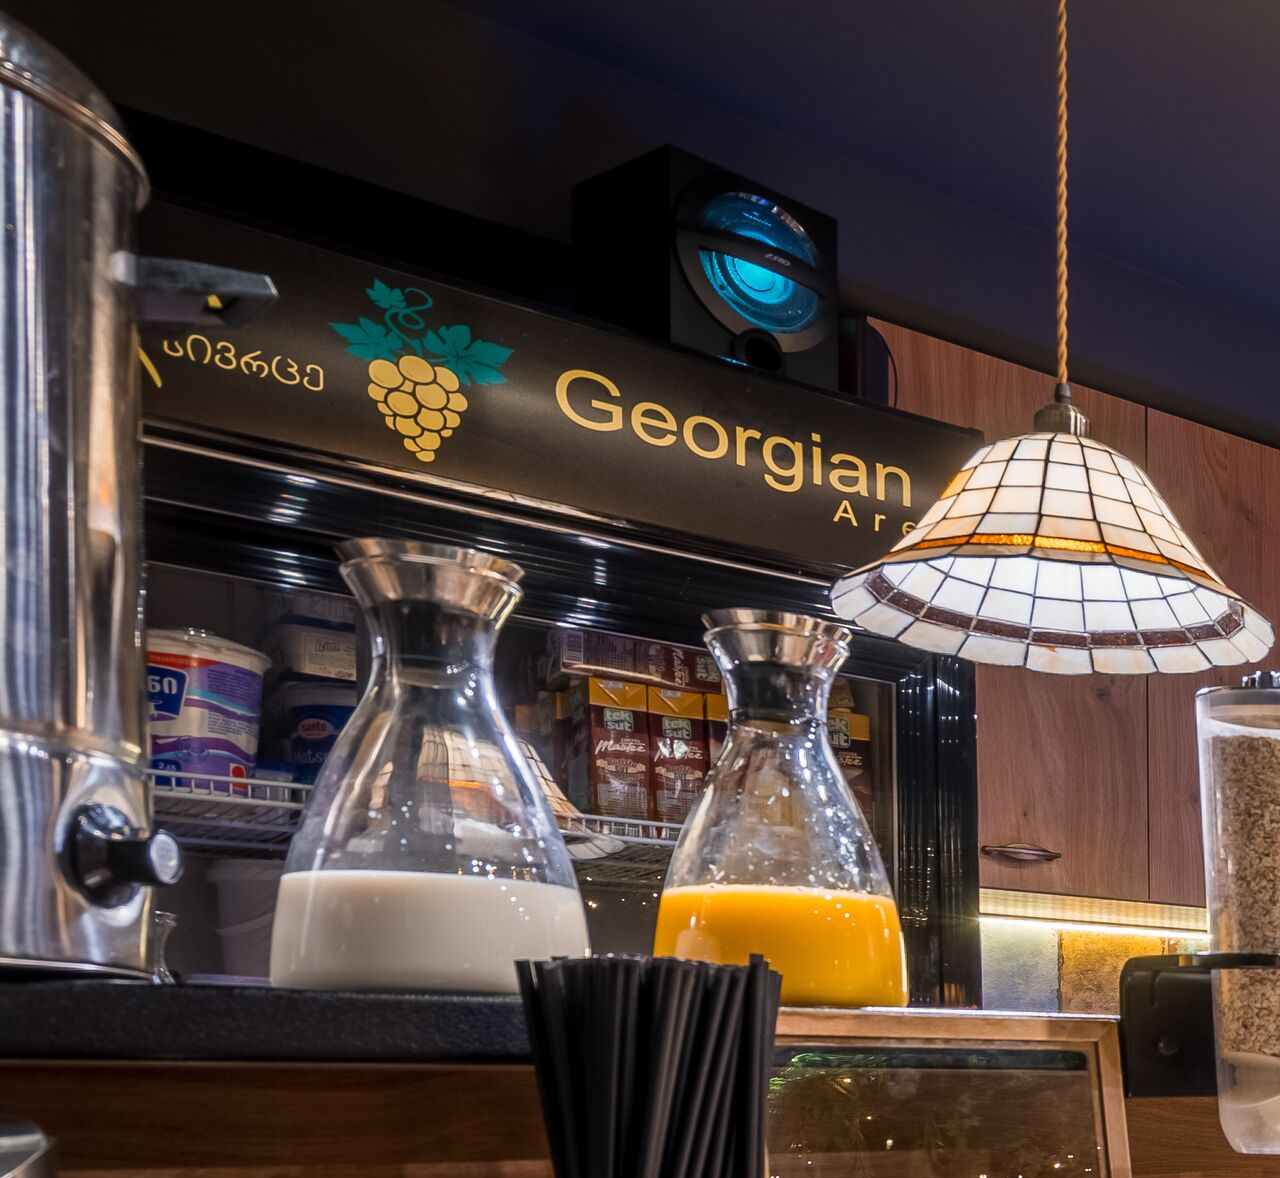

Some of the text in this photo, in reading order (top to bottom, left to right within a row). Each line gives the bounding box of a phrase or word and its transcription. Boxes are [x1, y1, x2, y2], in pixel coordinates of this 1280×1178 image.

[555, 369, 912, 507] Georgian
[605, 709, 631, 721] tek
[301, 721, 327, 732] sante
[664, 717, 689, 730] tek
